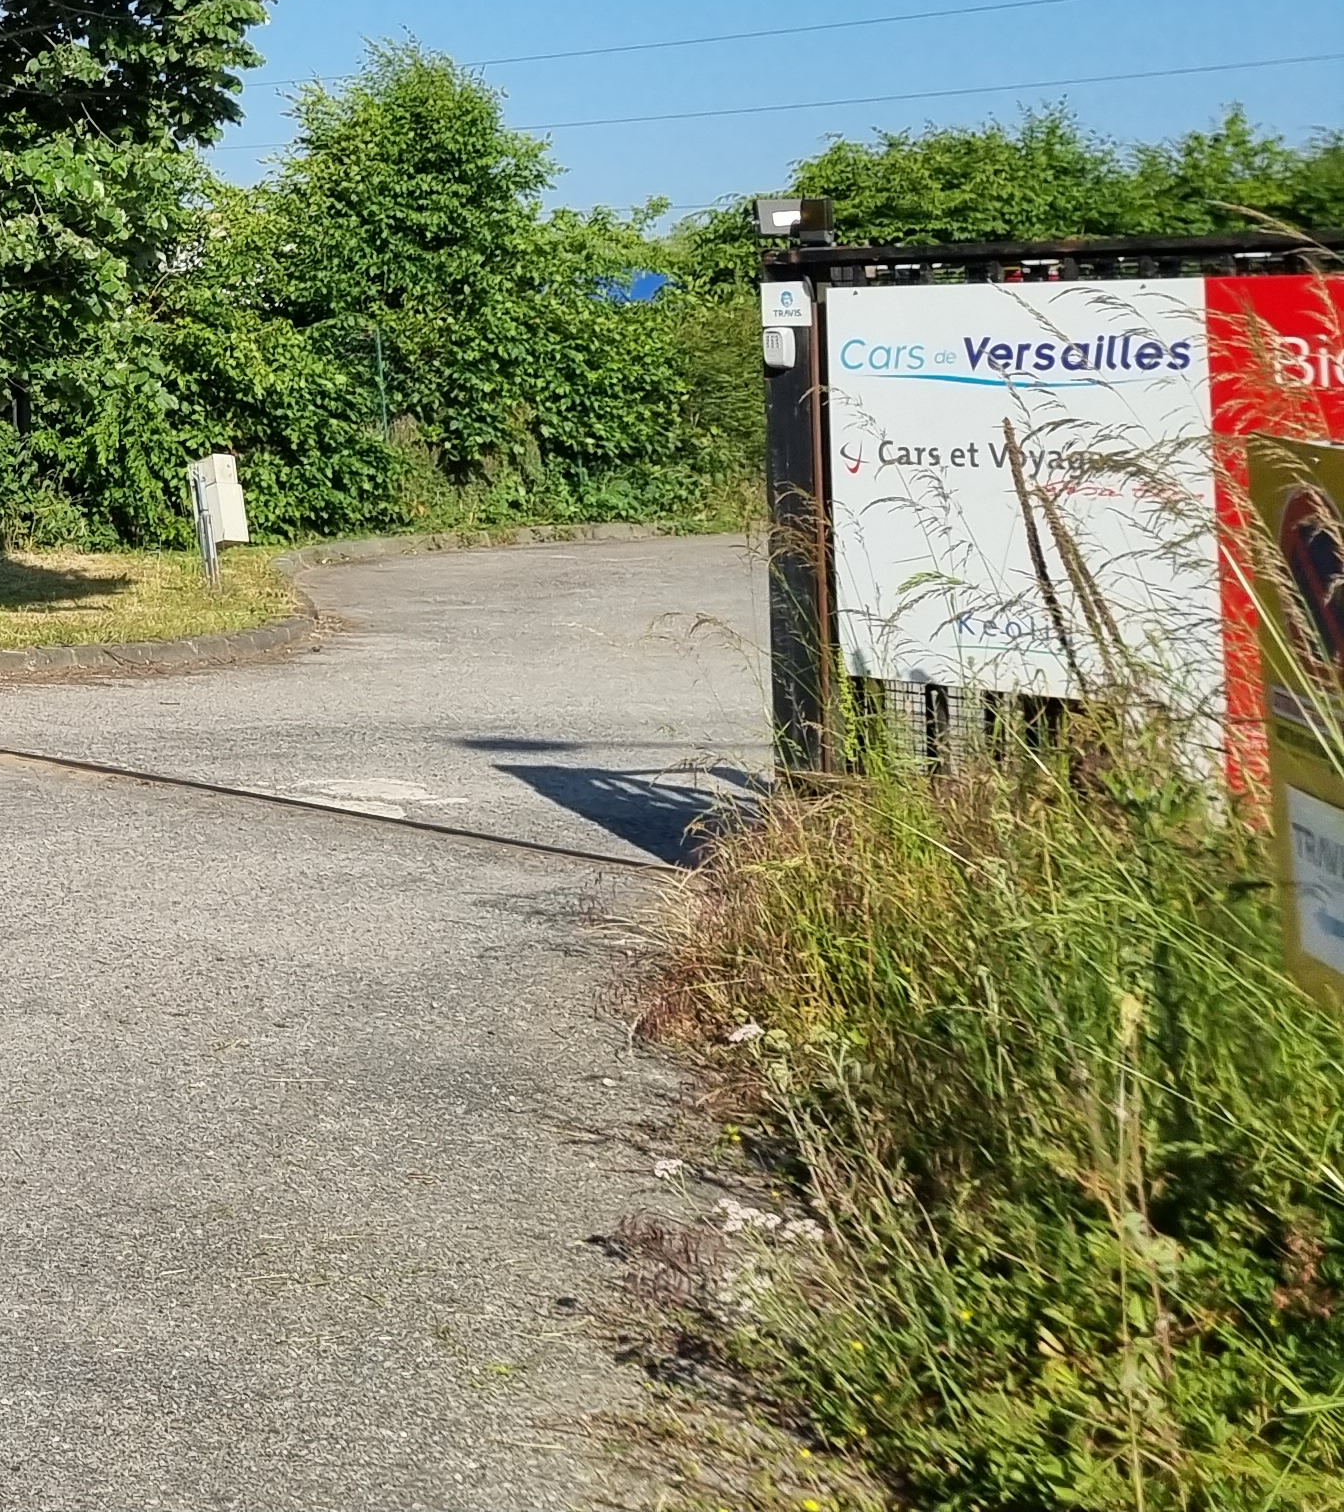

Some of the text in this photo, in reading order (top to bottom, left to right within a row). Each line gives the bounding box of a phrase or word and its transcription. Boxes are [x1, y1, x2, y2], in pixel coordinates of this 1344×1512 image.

[773, 308, 803, 318] TRAVIS
[840, 335, 1192, 373] Cars de Versailles
[1273, 336, 1344, 389] Bi
[878, 440, 940, 467] Cars
[950, 442, 979, 468] et
